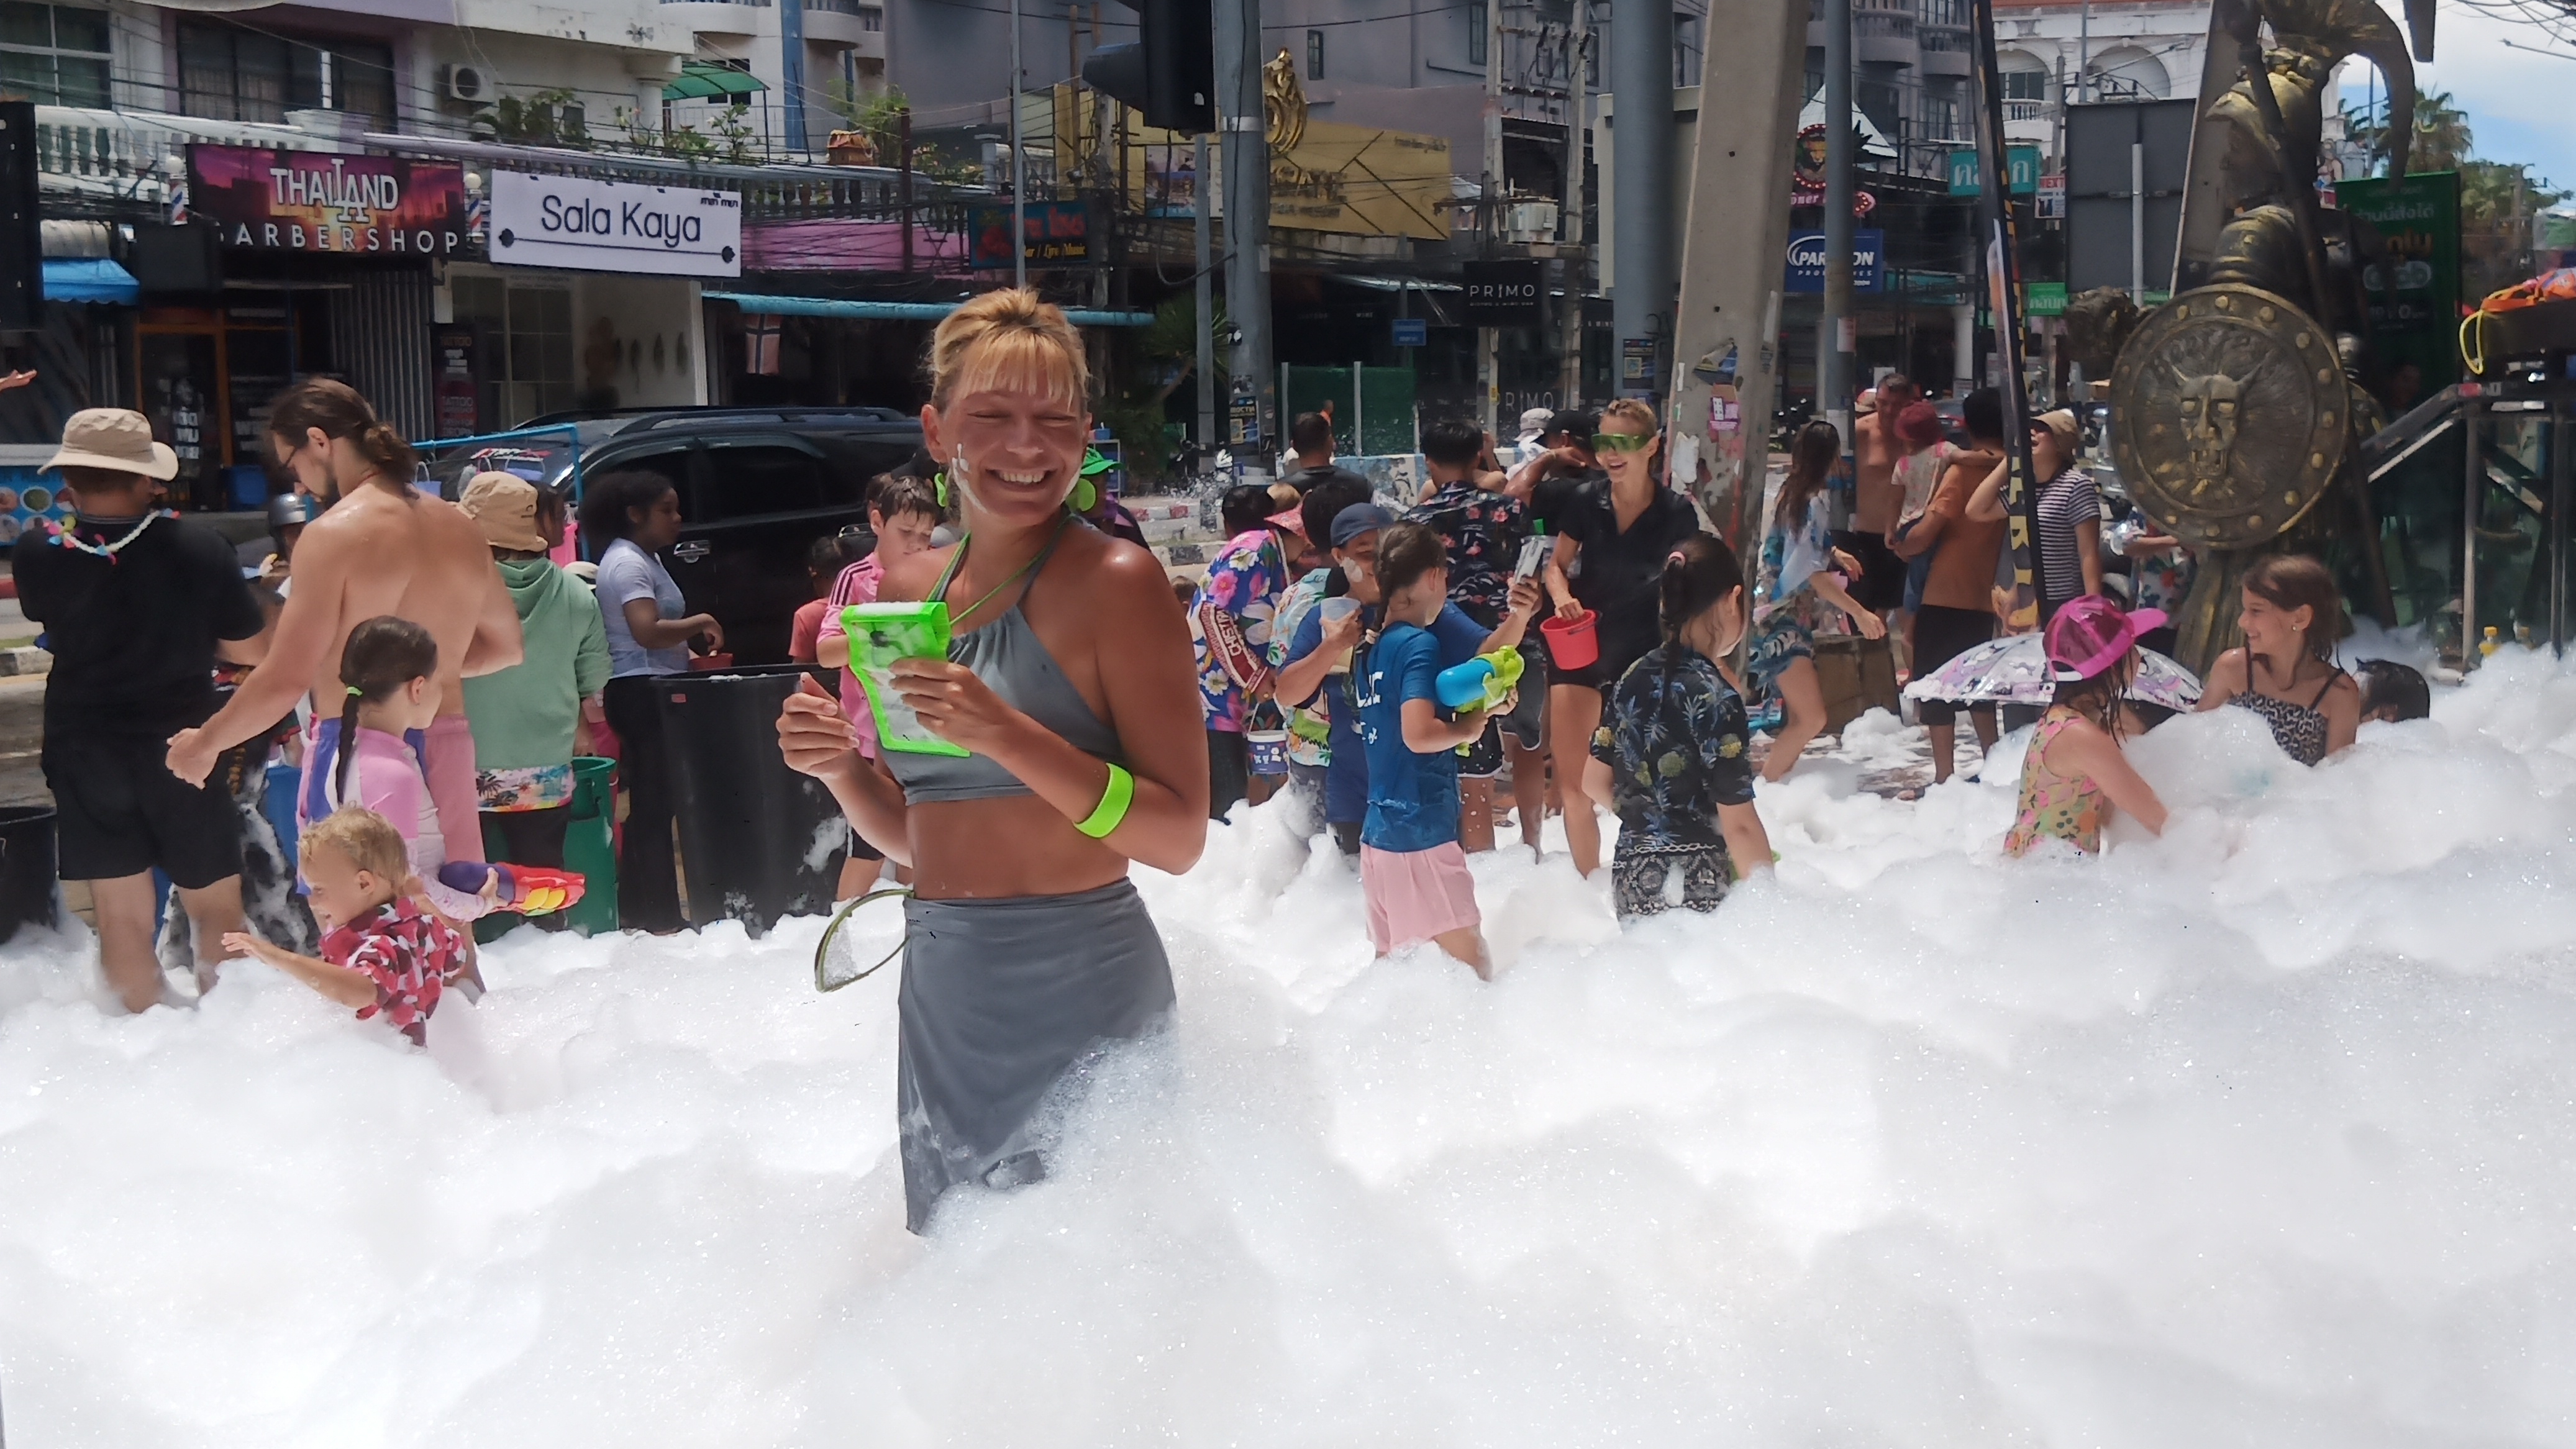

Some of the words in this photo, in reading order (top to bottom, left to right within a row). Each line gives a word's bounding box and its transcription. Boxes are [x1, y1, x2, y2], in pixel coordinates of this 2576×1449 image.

[270, 158, 398, 222] THAILAND
[542, 194, 611, 235] Sala
[622, 201, 701, 248] Kaya
[219, 221, 458, 253] ARBERSHOP
[1799, 251, 1875, 266] PARON
[1469, 284, 1536, 298] PRIMO
[442, 396, 473, 407] TATTOO
[1497, 390, 1554, 412] RIMO
